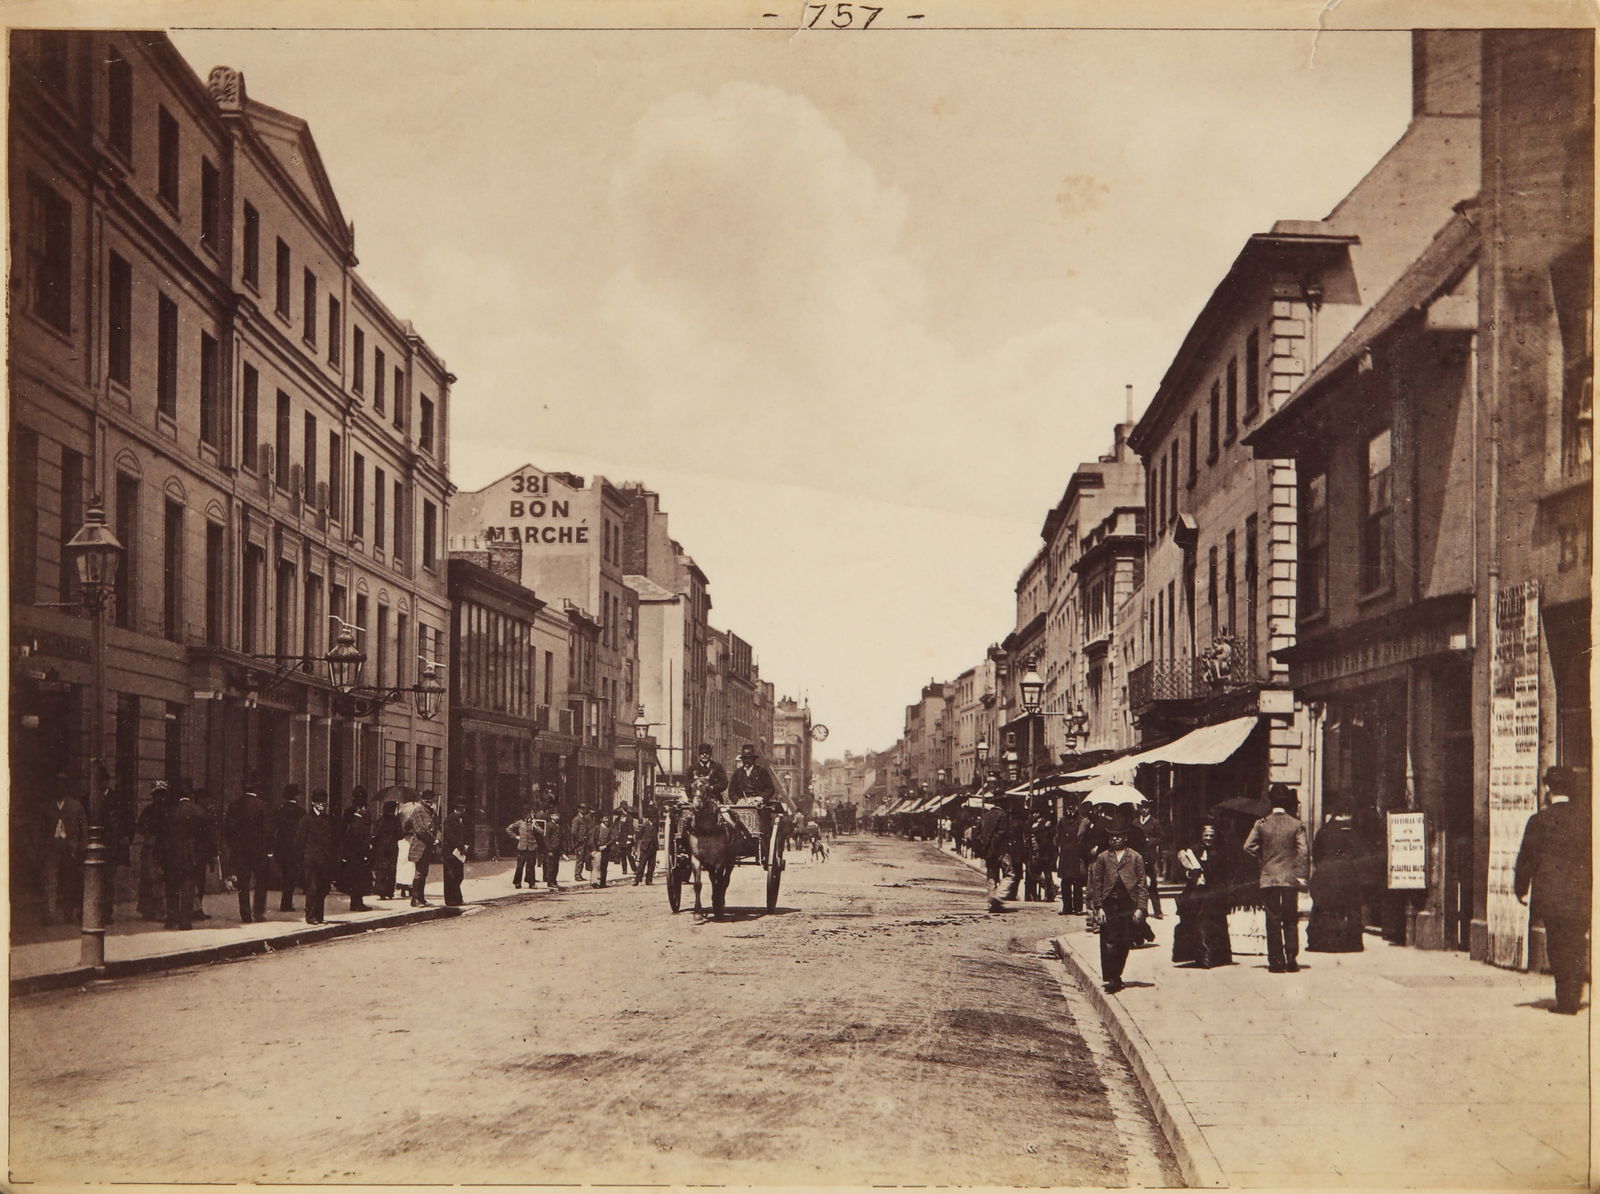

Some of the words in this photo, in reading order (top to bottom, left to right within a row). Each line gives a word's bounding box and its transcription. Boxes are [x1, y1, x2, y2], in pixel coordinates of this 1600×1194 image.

[808, 3, 883, 30] 757
[511, 475, 549, 494] 381
[510, 500, 569, 518] BON
